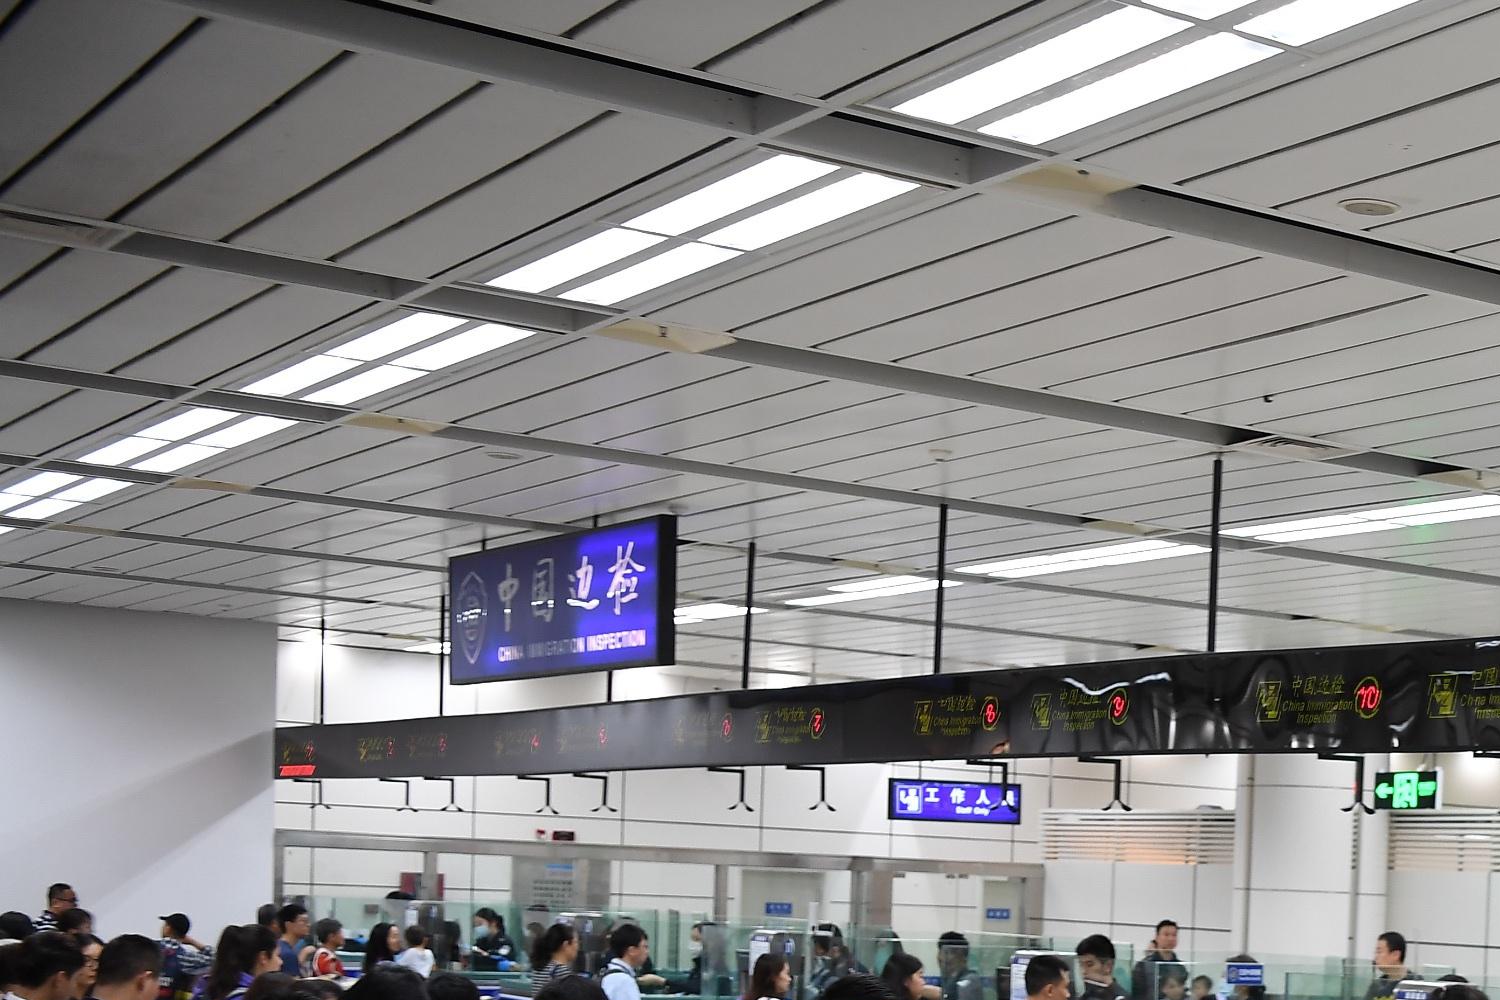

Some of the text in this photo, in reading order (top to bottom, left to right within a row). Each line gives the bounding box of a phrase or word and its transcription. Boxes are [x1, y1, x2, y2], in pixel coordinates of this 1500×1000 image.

[498, 541, 646, 632] 中国边检
[587, 629, 646, 651] INSPECTION
[1113, 696, 1125, 717] 9
[1358, 686, 1380, 709] 10
[986, 703, 996, 723] 8
